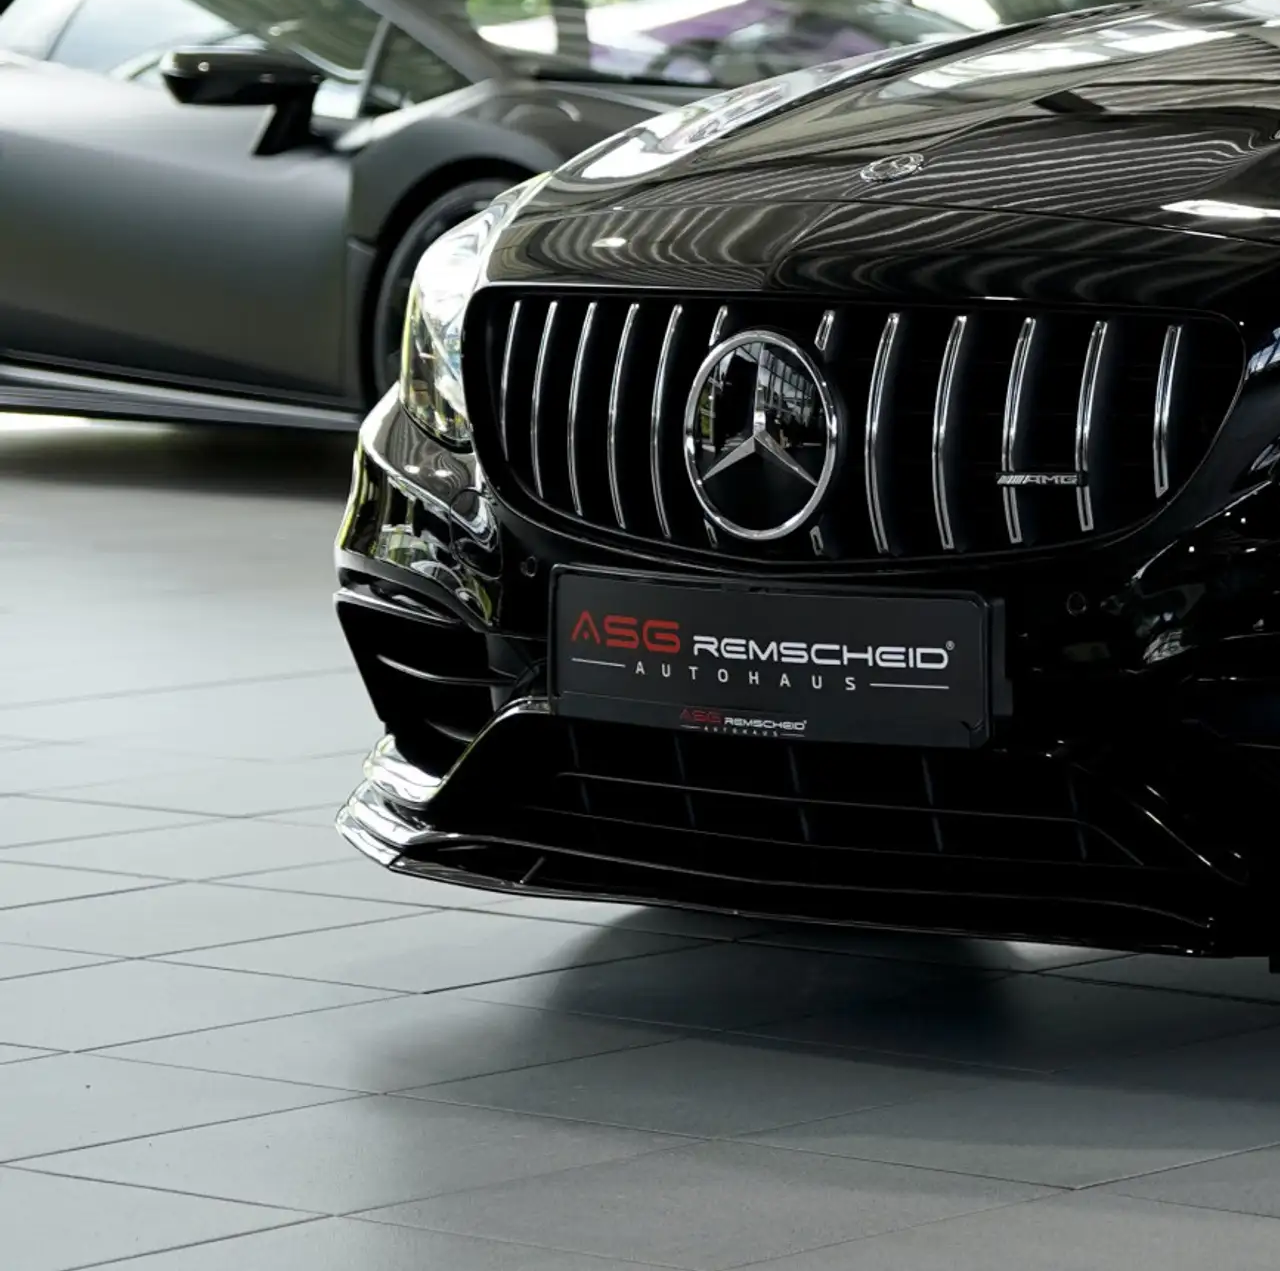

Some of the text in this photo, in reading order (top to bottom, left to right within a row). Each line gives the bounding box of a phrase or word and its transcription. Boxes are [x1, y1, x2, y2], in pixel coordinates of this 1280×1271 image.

[1022, 475, 1078, 484] AMG
[571, 610, 681, 653] ASG
[636, 660, 856, 691] AUTOHAUS
